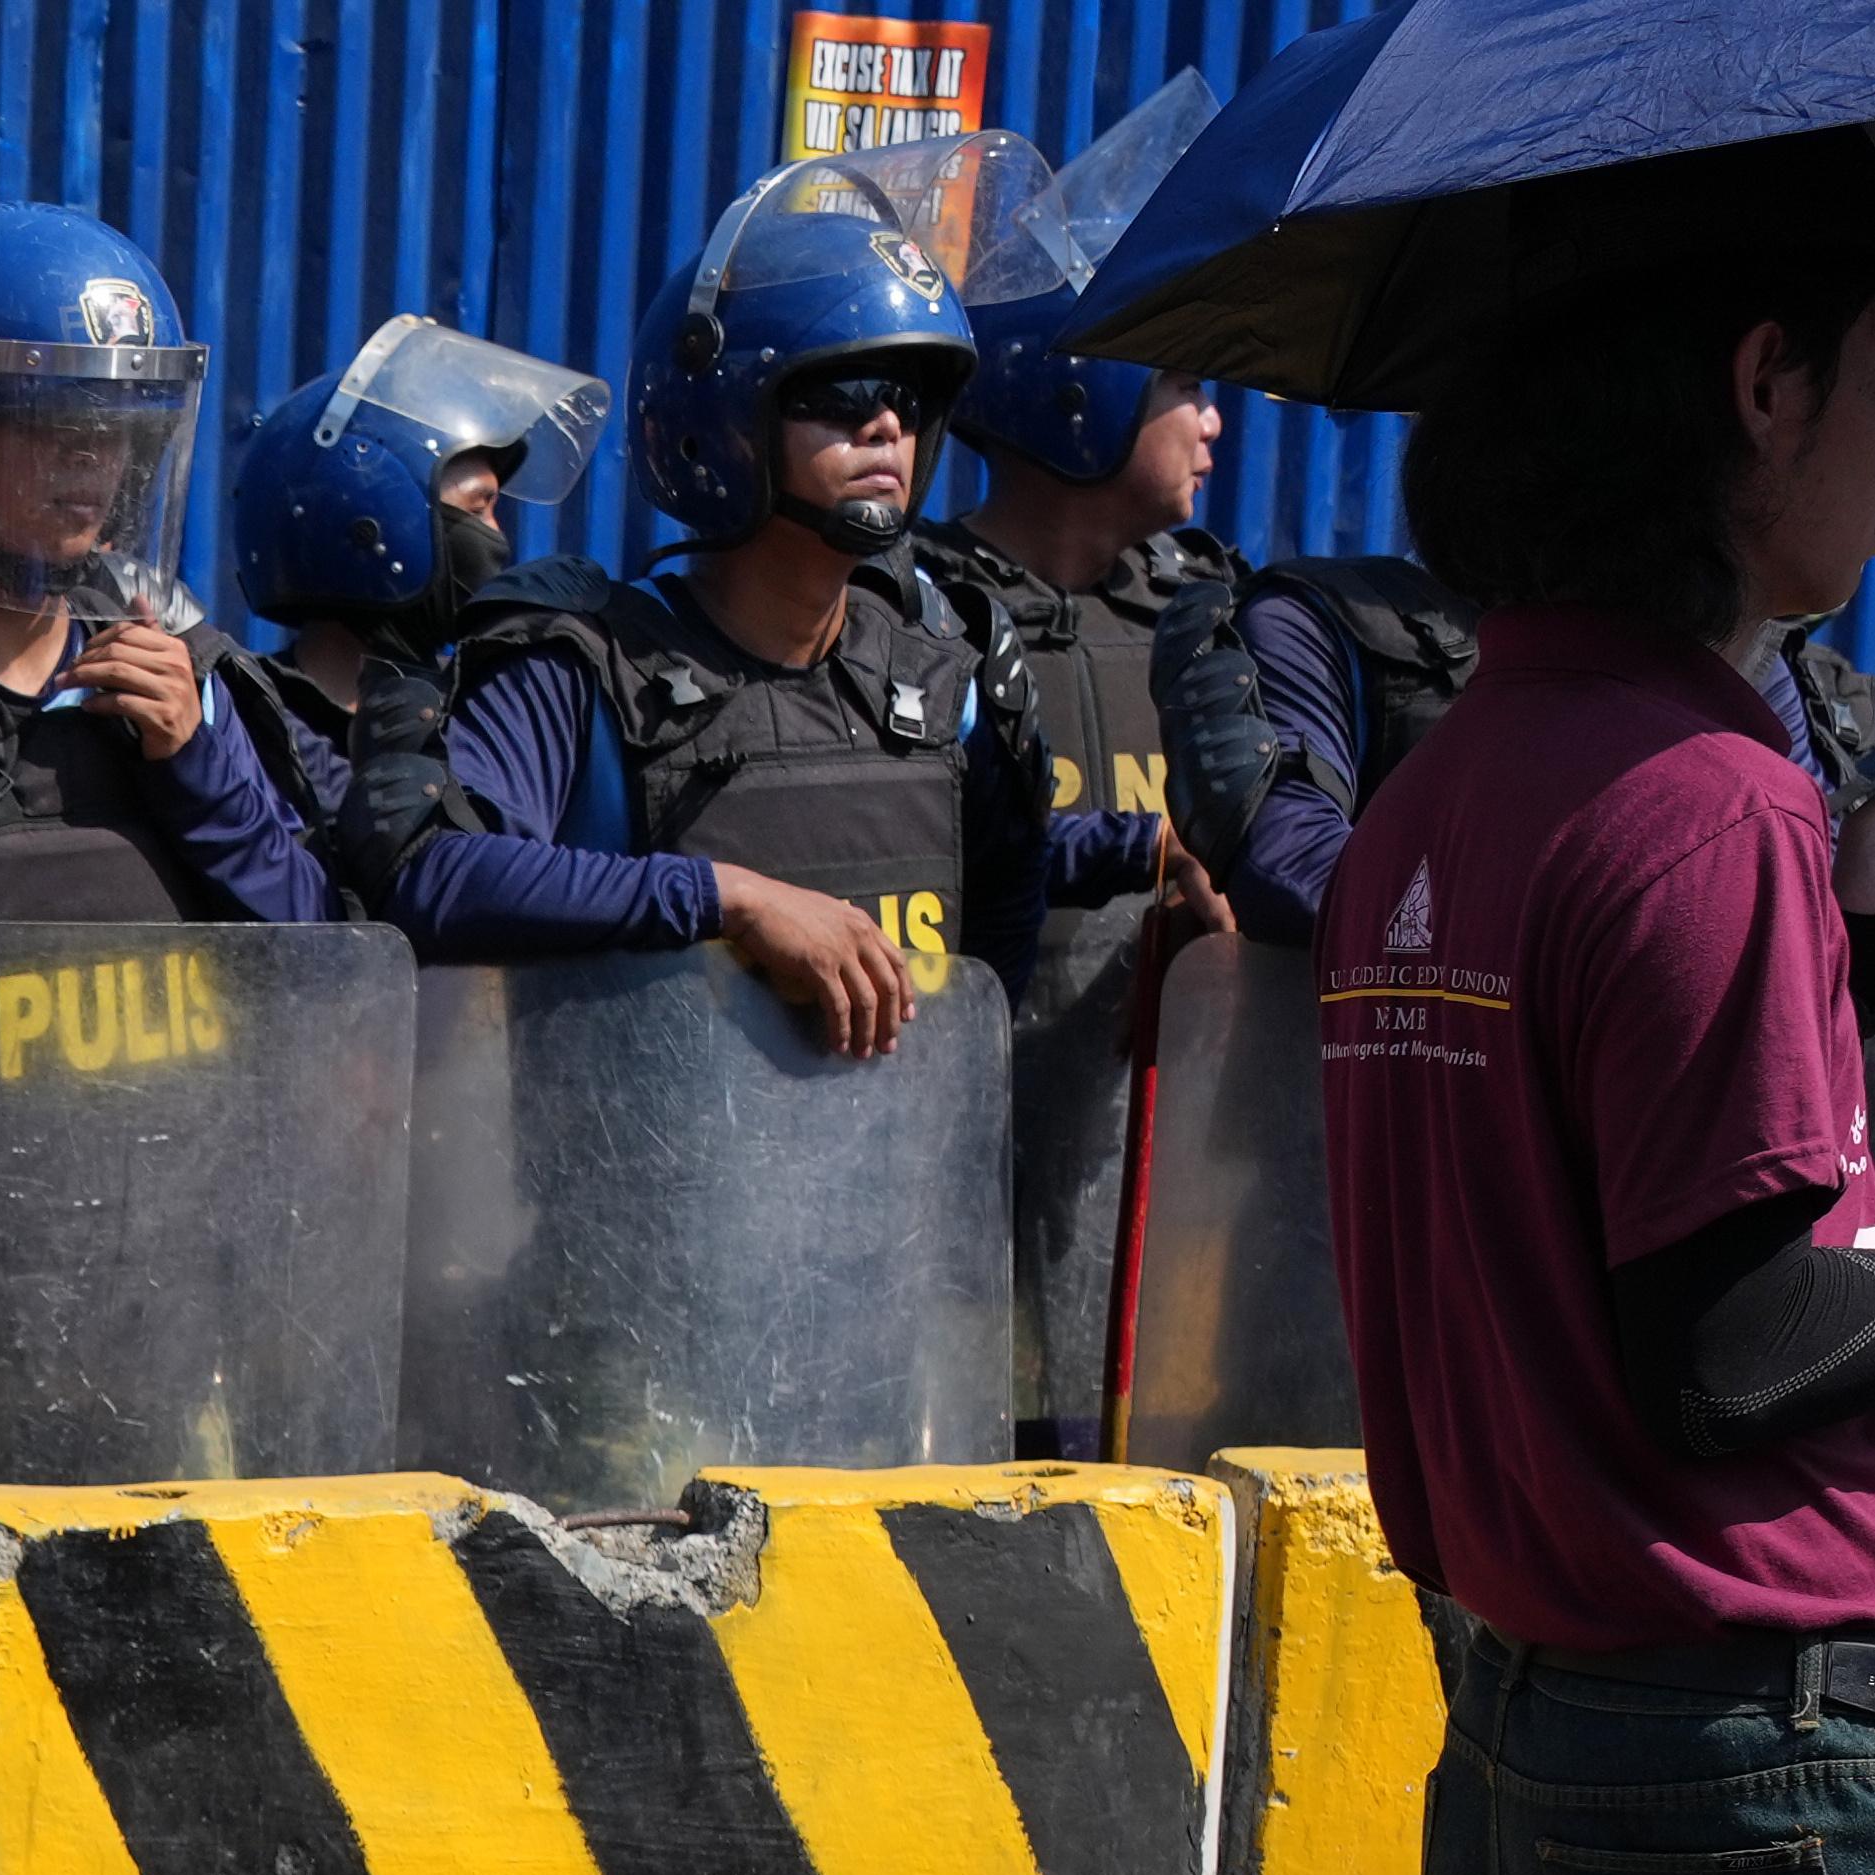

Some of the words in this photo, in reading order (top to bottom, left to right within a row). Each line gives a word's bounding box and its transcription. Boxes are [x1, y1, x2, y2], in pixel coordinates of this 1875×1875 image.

[811, 39, 886, 94] EXCISE
[889, 47, 933, 98] TAX
[935, 48, 965, 99] AT
[805, 100, 842, 152] VAT
[843, 104, 877, 153] SA
[1451, 968, 1511, 996] UNION
